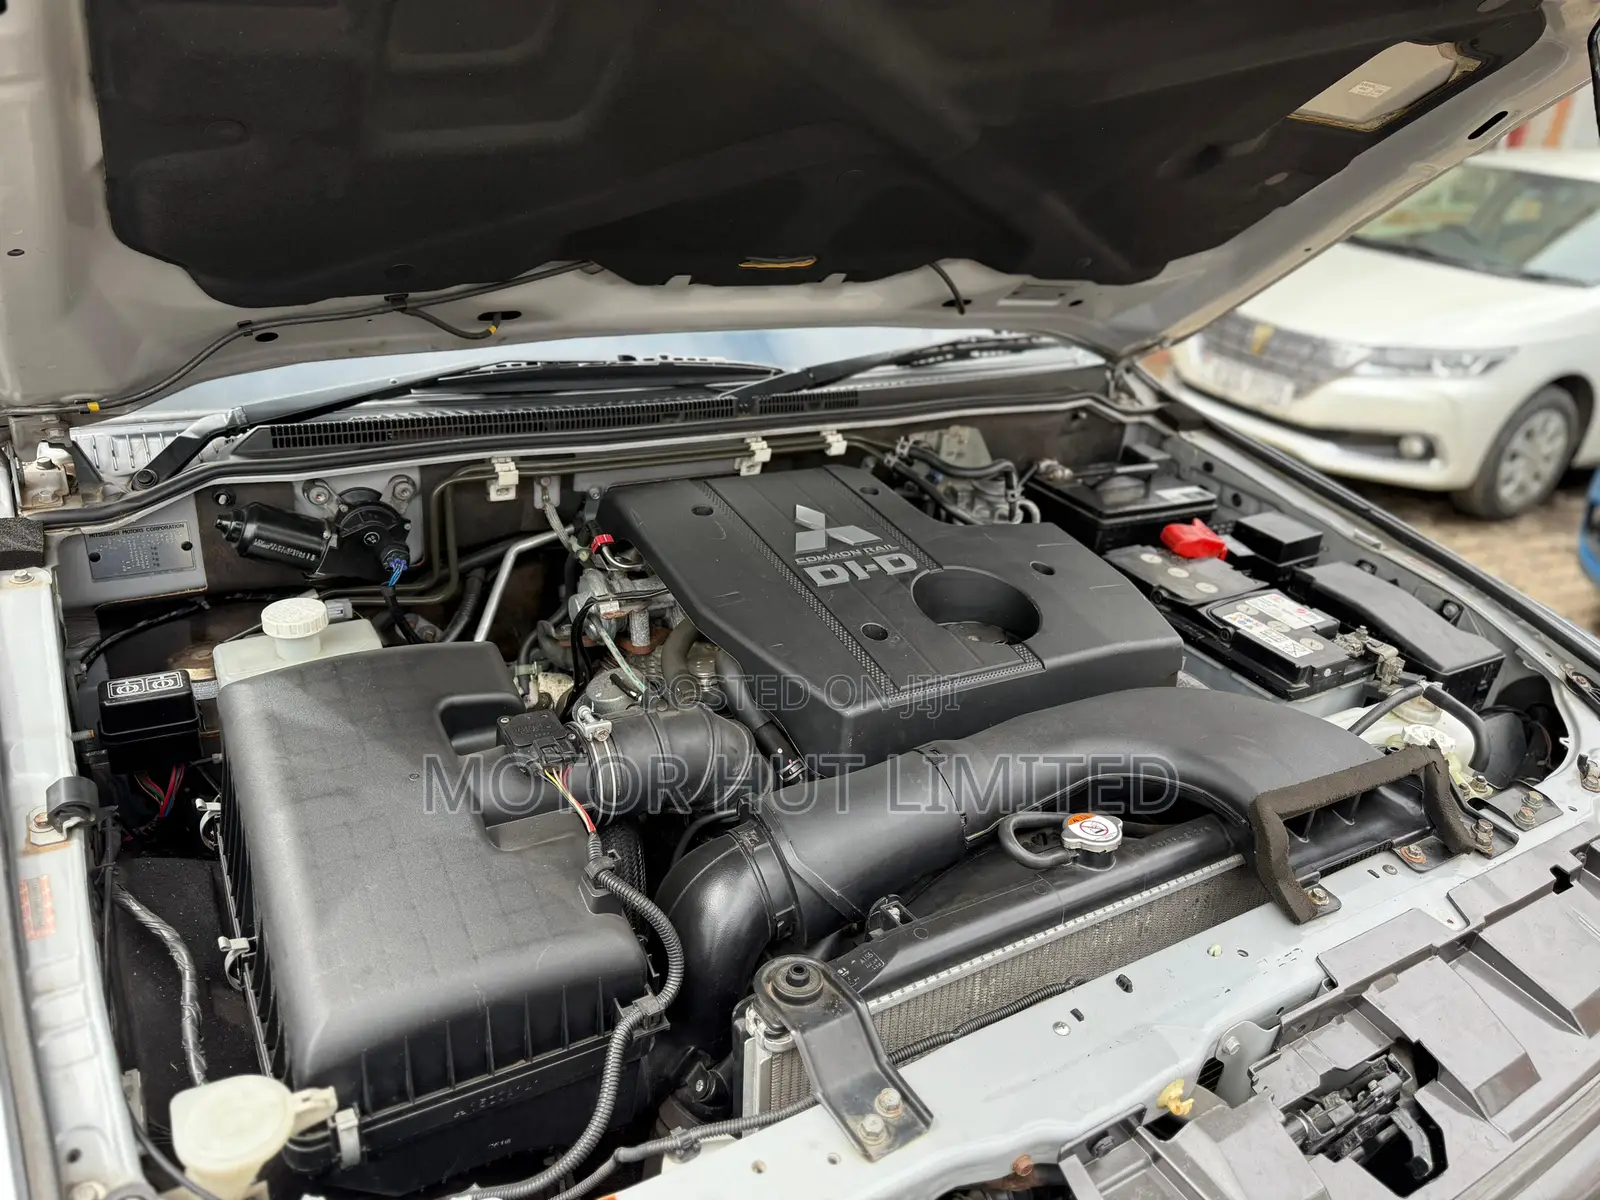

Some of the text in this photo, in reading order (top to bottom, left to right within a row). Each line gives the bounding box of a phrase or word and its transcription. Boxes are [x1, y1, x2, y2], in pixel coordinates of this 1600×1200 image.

[122, 528, 144, 536] MOTORS
[146, 523, 185, 533] CORPORATION
[795, 544, 900, 565] COMMON RAIL
[803, 553, 917, 587] DI-D
